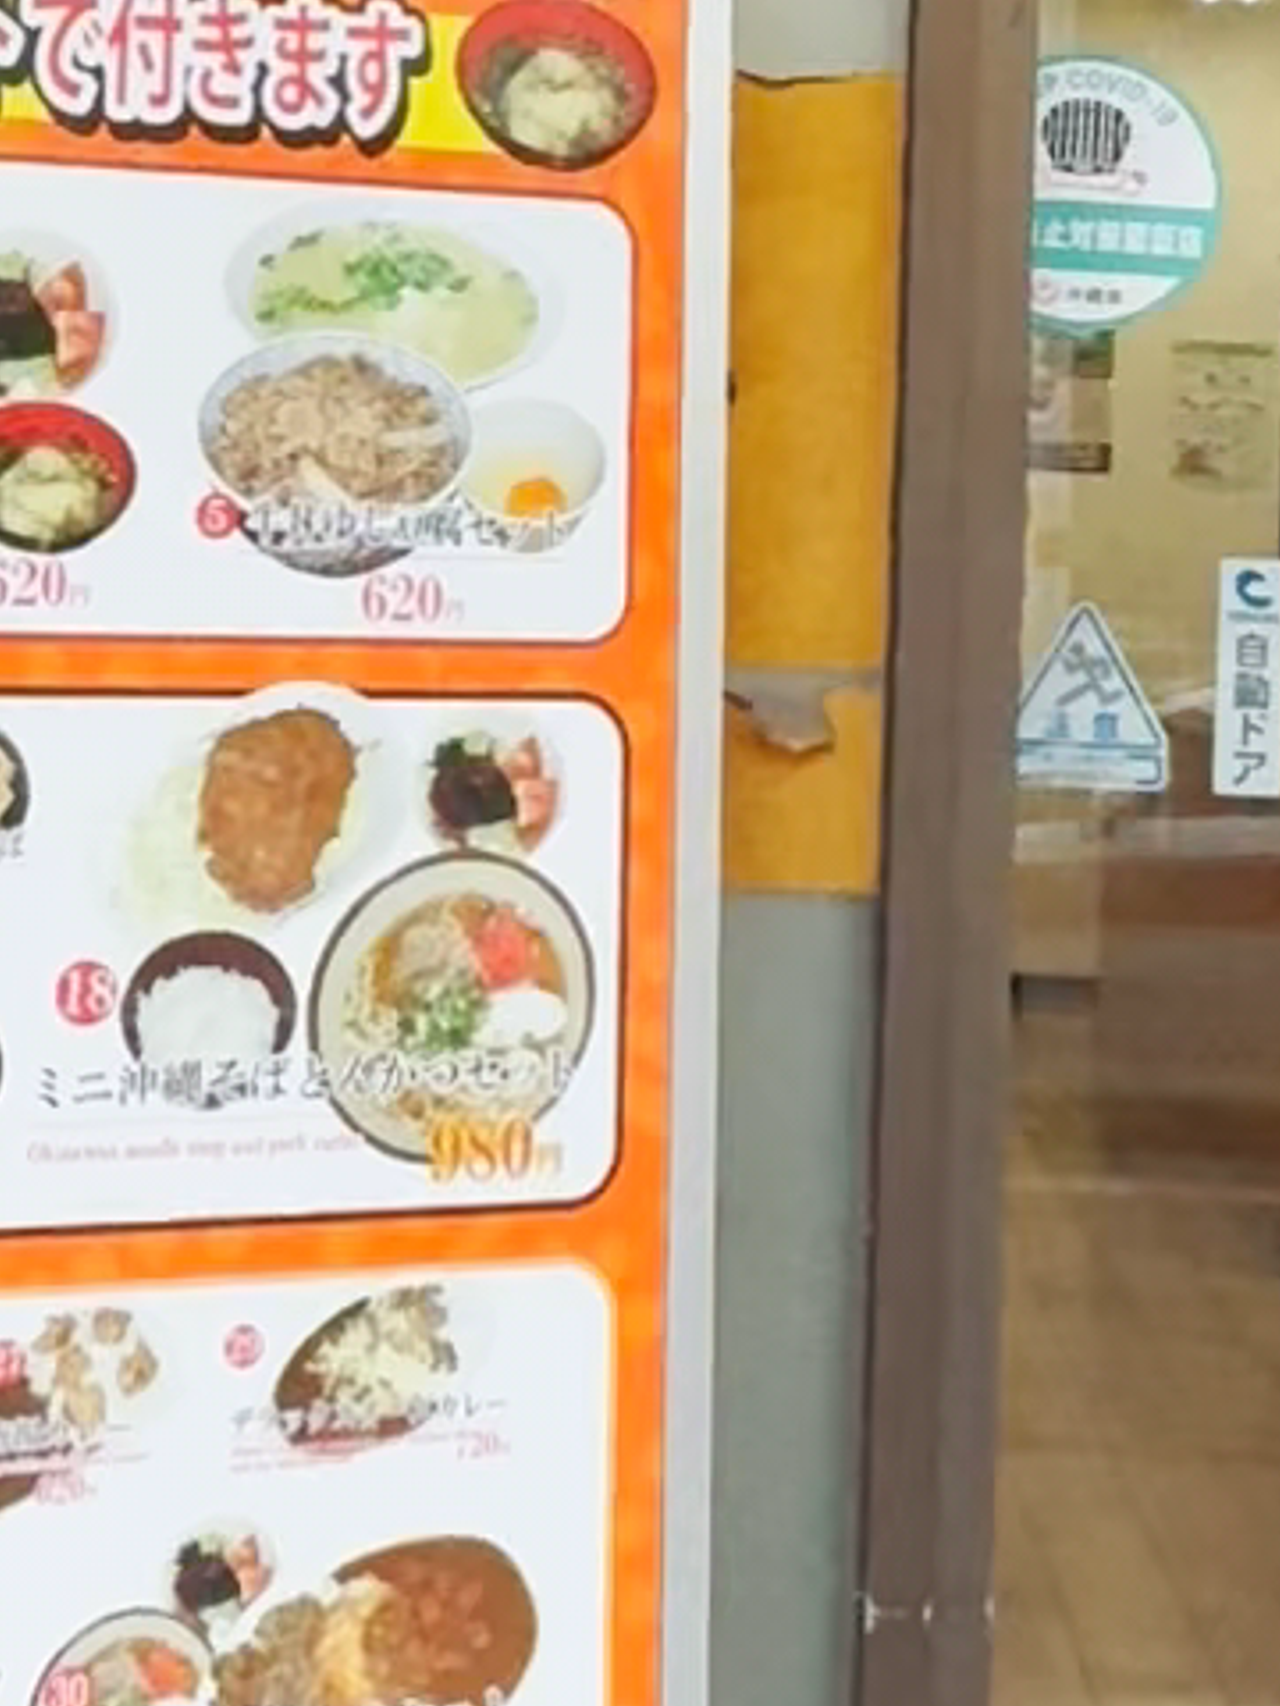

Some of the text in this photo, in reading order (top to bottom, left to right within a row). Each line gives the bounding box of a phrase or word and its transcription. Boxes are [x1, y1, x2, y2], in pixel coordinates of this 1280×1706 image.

[1232, 631, 1271, 787] 自動ドア
[428, 1116, 565, 1183] 980円
